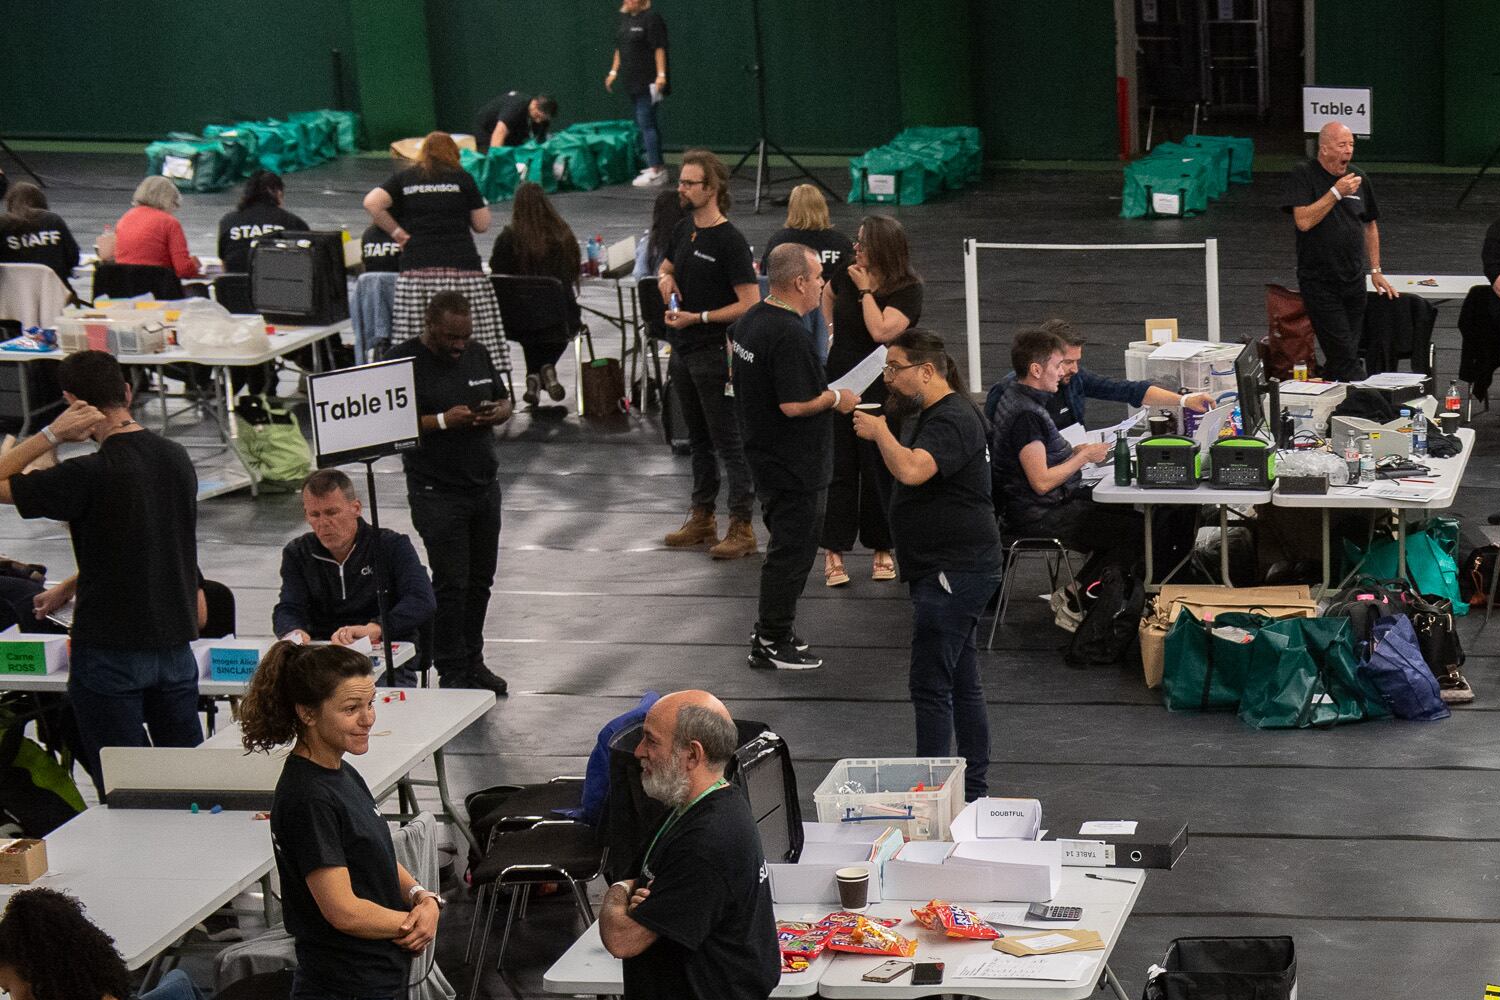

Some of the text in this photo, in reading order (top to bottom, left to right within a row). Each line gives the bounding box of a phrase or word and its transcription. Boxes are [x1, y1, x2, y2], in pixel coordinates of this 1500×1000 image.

[1310, 102, 1366, 116] Table 4
[316, 387, 409, 423] Table 15
[8, 663, 36, 672] ROSS
[990, 810, 1025, 818] DOUBTFUL
